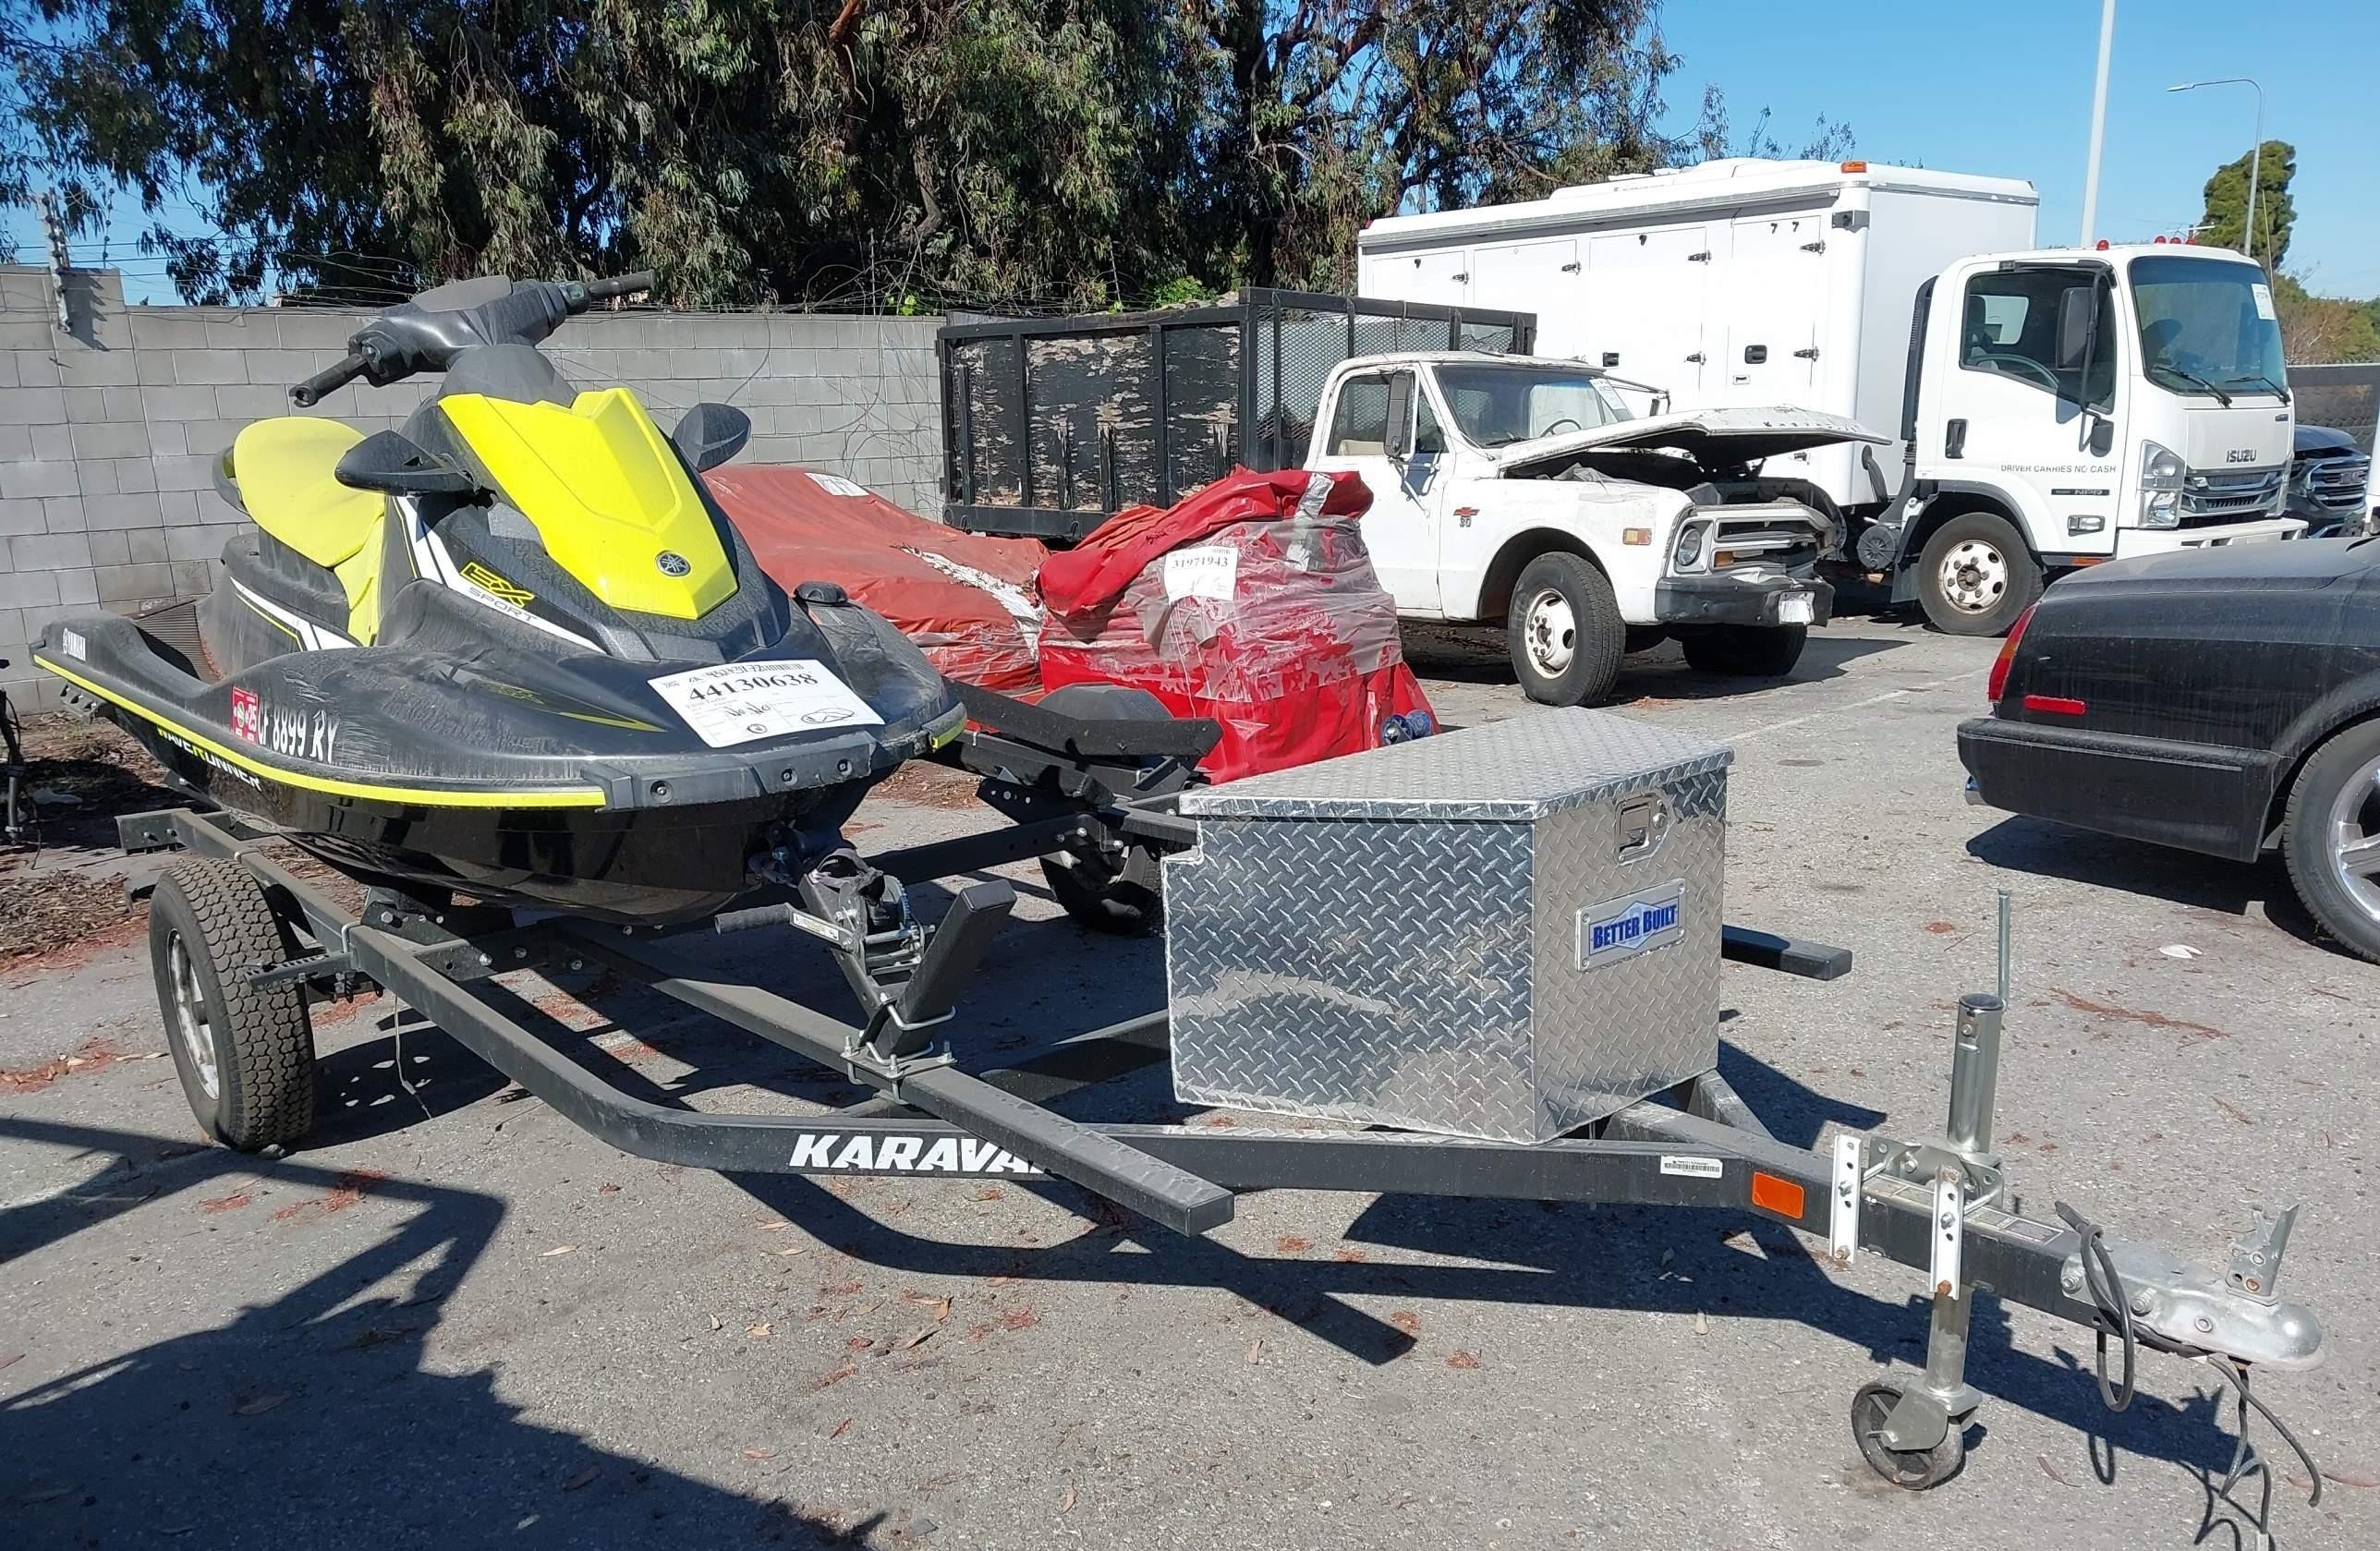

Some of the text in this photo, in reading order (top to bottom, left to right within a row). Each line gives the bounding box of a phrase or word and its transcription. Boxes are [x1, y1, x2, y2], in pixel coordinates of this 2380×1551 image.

[2034, 465, 2072, 473] CARRIES
[2090, 465, 2117, 473] CASH
[2226, 449, 2257, 463] ISUZU
[1172, 556, 1229, 569] 31971943
[461, 561, 536, 608] EX
[468, 587, 538, 621] SPORT
[689, 673, 819, 700] 44130638
[248, 704, 258, 733] 25
[272, 704, 307, 757] 8899
[309, 708, 341, 764] RY
[156, 726, 262, 792] WAVERUNNER
[1593, 904, 1677, 949] BETTER BUILT
[789, 1133, 1045, 1174] KARAVA
